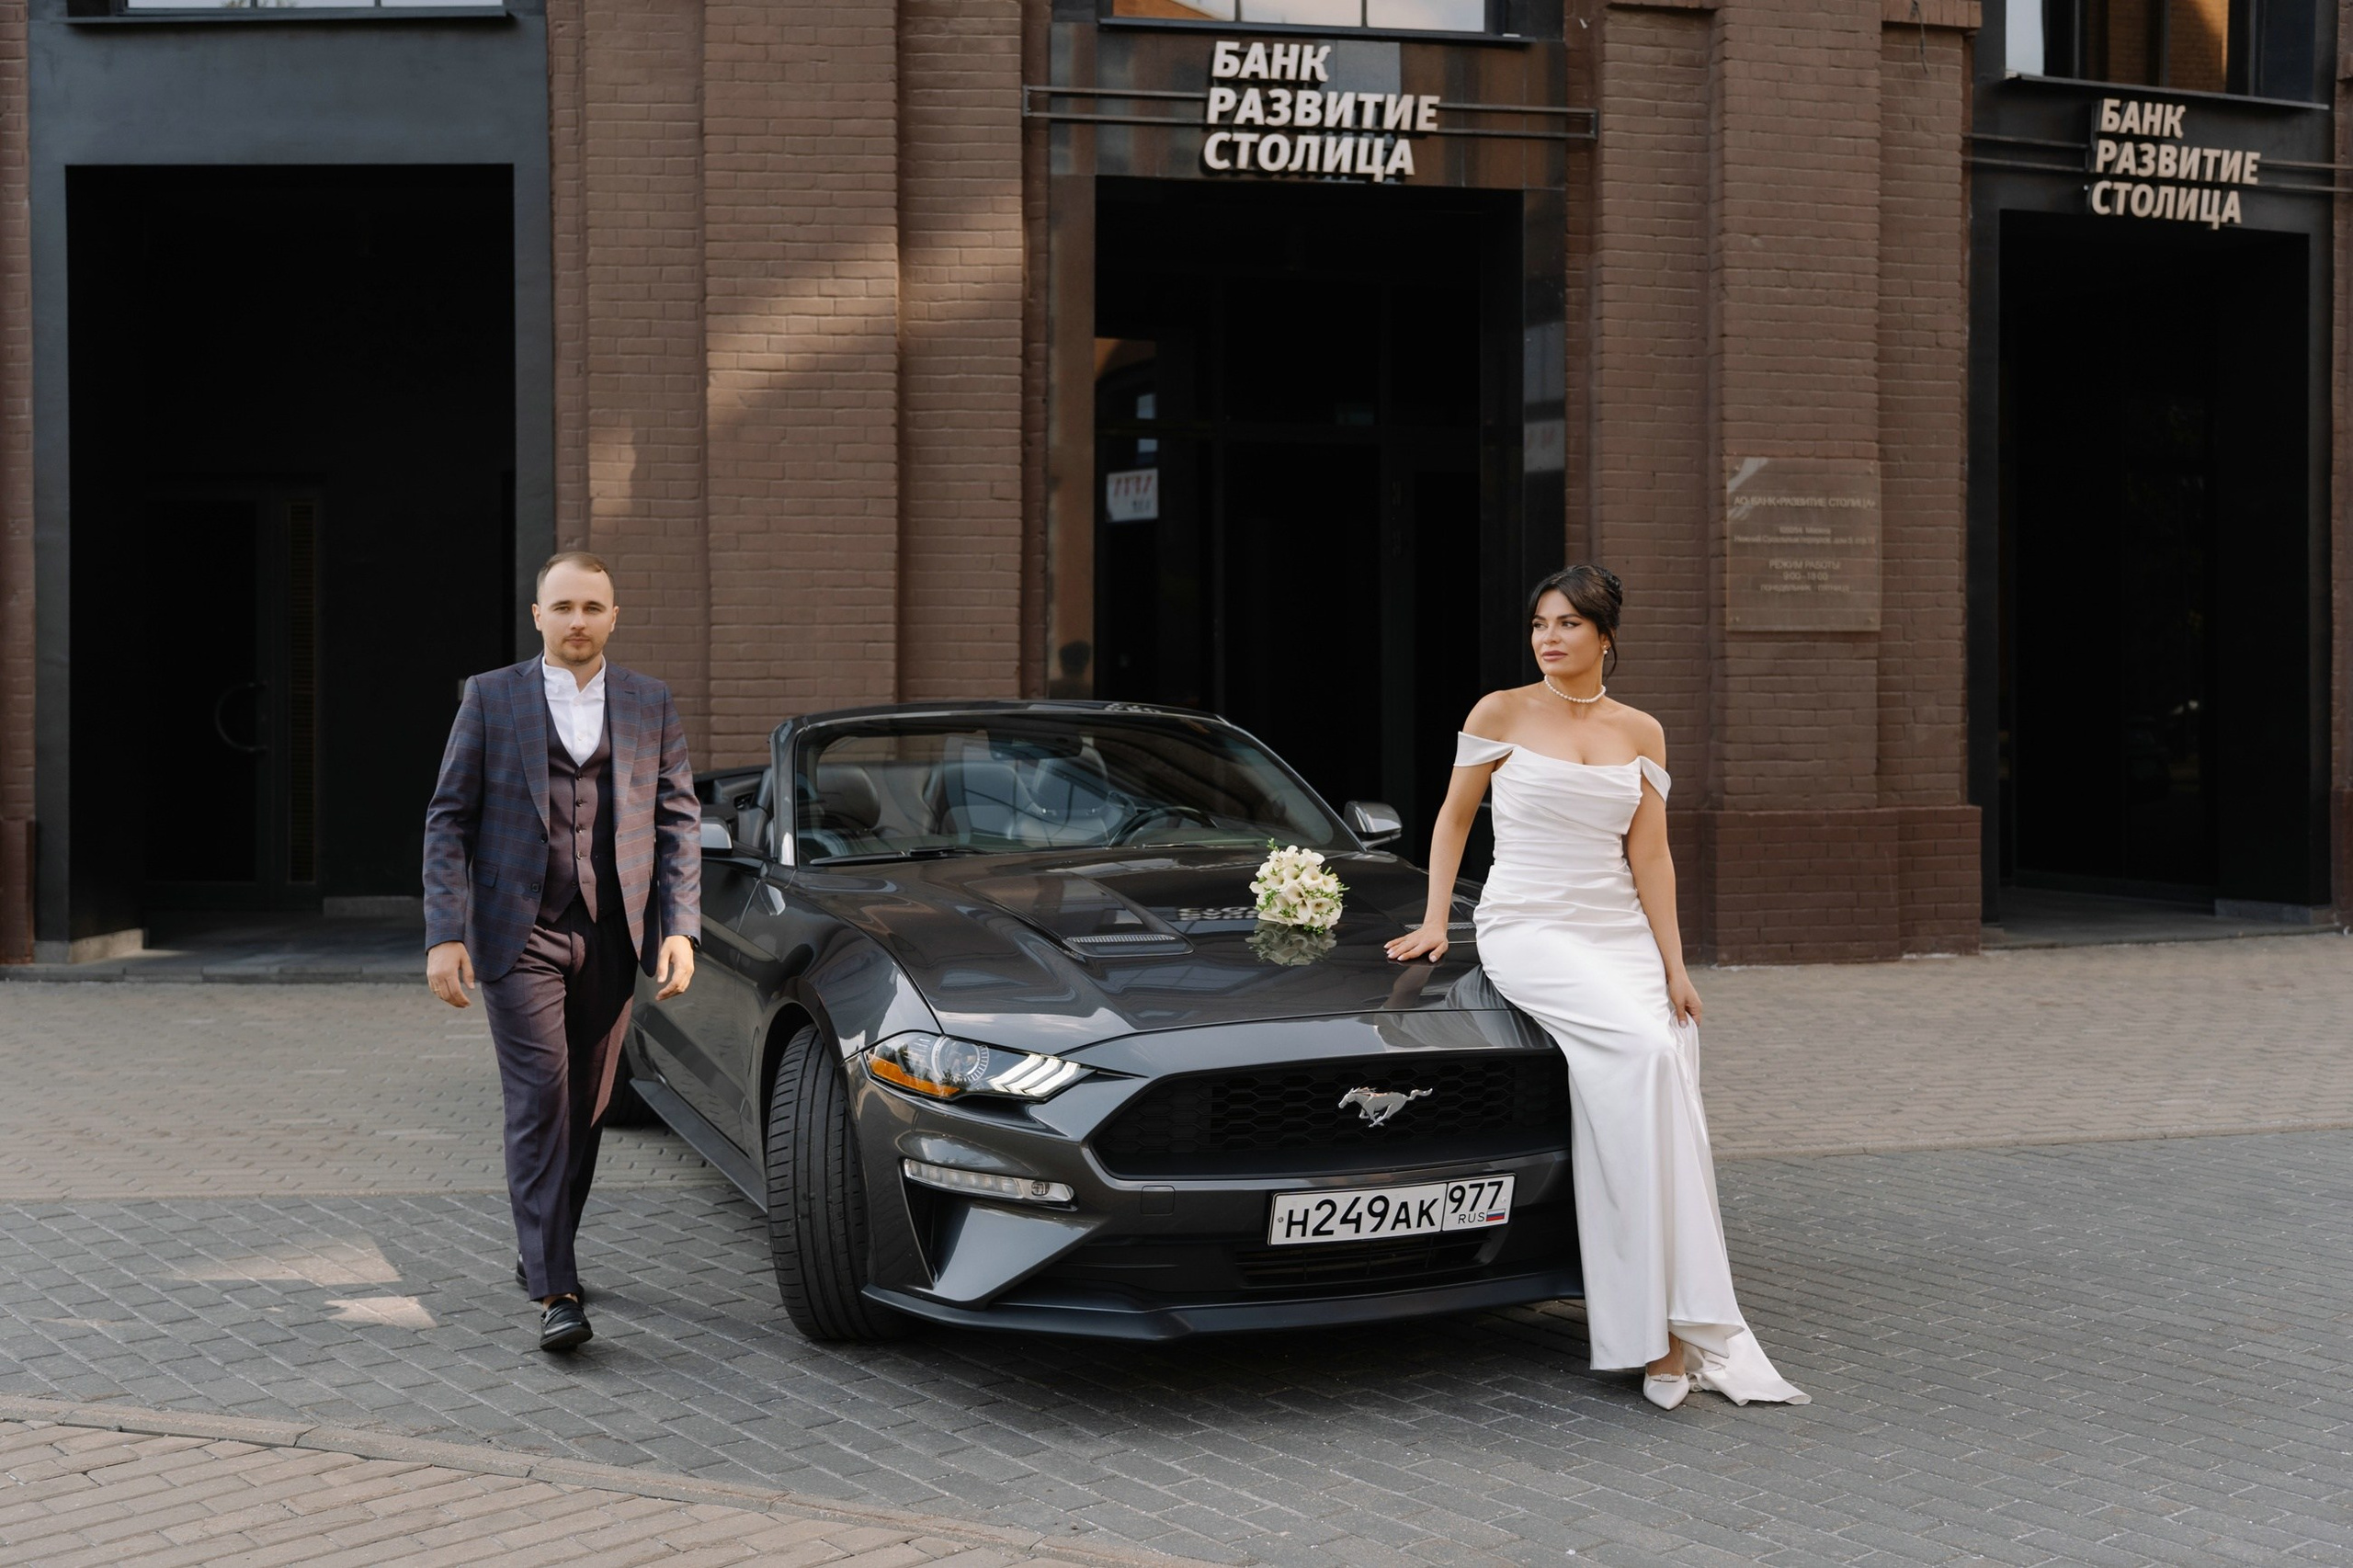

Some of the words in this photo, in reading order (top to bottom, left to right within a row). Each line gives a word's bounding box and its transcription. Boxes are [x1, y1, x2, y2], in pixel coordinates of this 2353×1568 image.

[1211, 41, 1331, 83] БАНК
[1207, 87, 1440, 132] РАЗВИТИЕ
[2100, 98, 2187, 139] БАНК
[1203, 131, 1415, 182] СТОЛИЦА
[2096, 139, 2261, 185] РАЗВИТИЕ
[2091, 180, 2242, 230] СТОЛИЦА
[1449, 1180, 1504, 1213] 977
[1458, 1211, 1485, 1224] RUS
